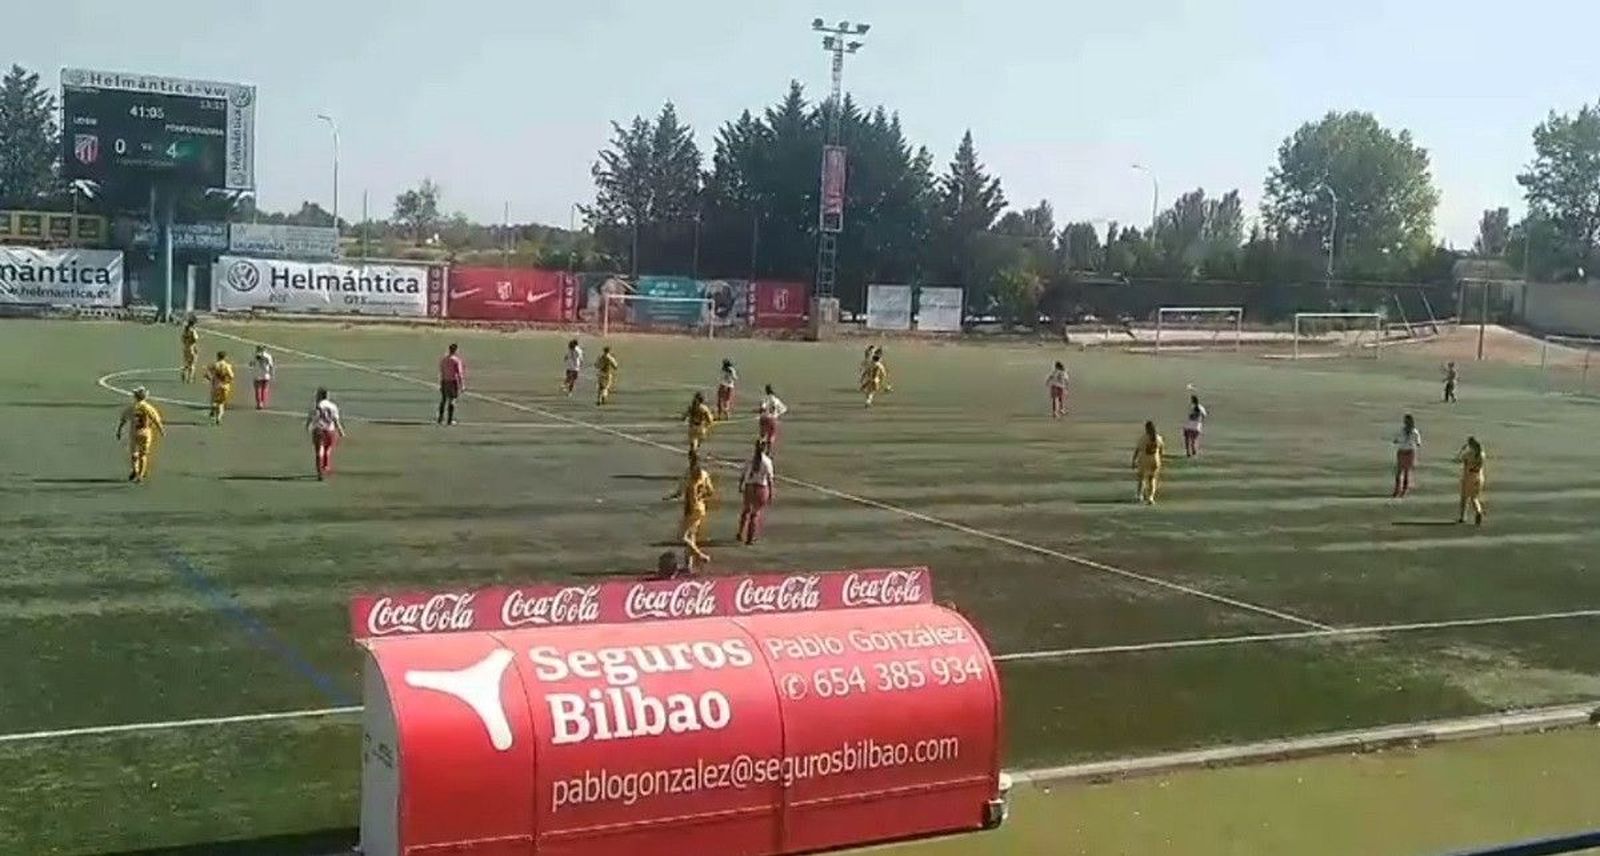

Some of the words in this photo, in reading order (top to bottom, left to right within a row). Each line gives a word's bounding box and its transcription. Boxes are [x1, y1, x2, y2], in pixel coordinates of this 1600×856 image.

[115, 138, 126, 154] 0
[166, 143, 177, 158] 4
[270, 266, 420, 293] Helmántica
[529, 638, 754, 685] Seguros
[766, 634, 843, 660] Pablo
[814, 666, 866, 697] 654
[874, 660, 926, 691] 385
[931, 656, 983, 685] 934
[545, 686, 731, 744] Bilbao
[552, 736, 959, 812] pablogonzalez@segurosbilbao.com
